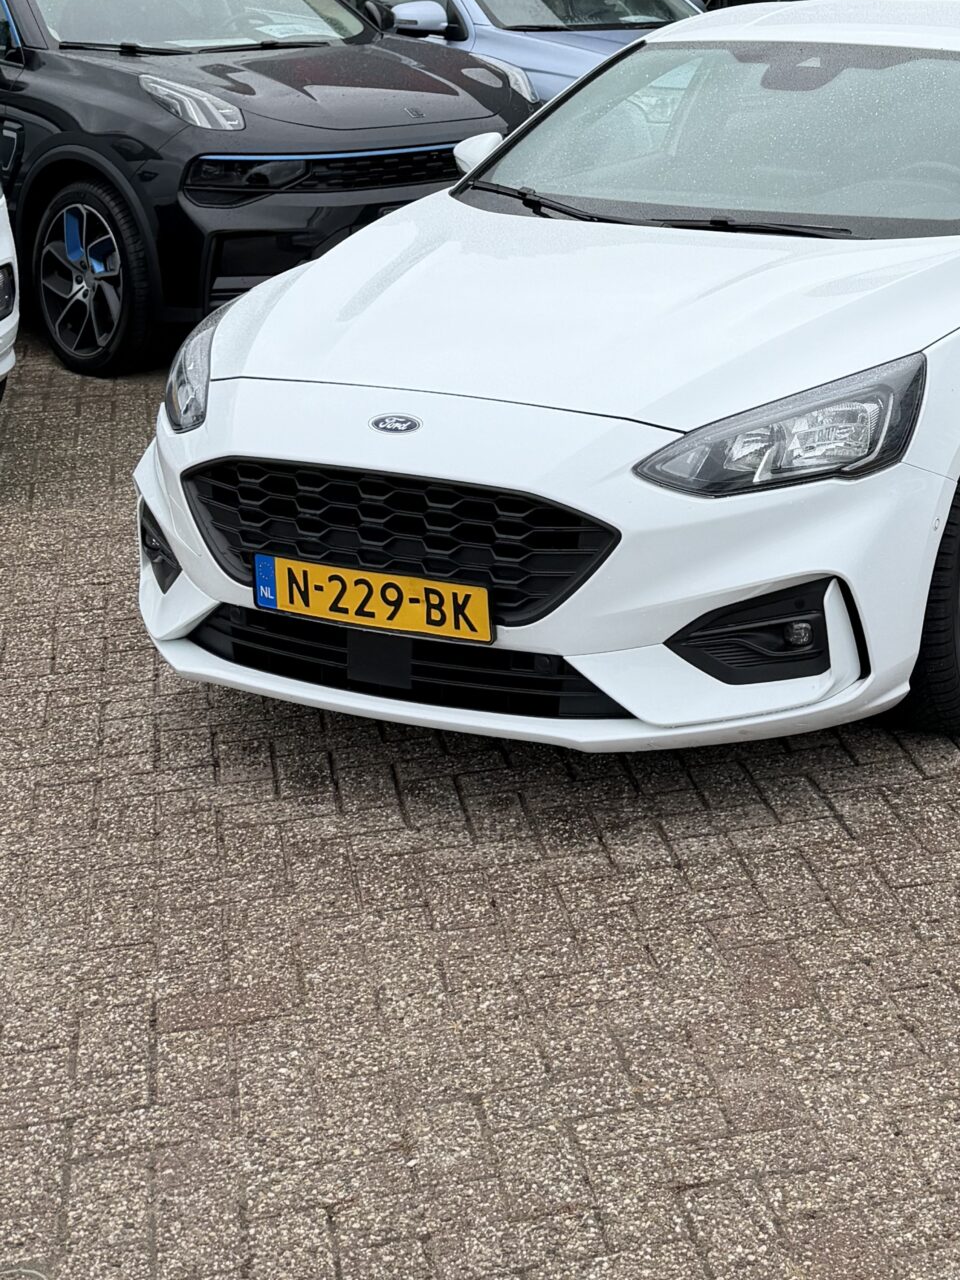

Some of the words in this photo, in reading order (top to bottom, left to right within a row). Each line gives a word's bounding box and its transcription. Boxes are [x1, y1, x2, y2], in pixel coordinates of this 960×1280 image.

[379, 417, 411, 430] Ford
[260, 585, 274, 600] NL
[287, 567, 478, 633] N-229-BK
